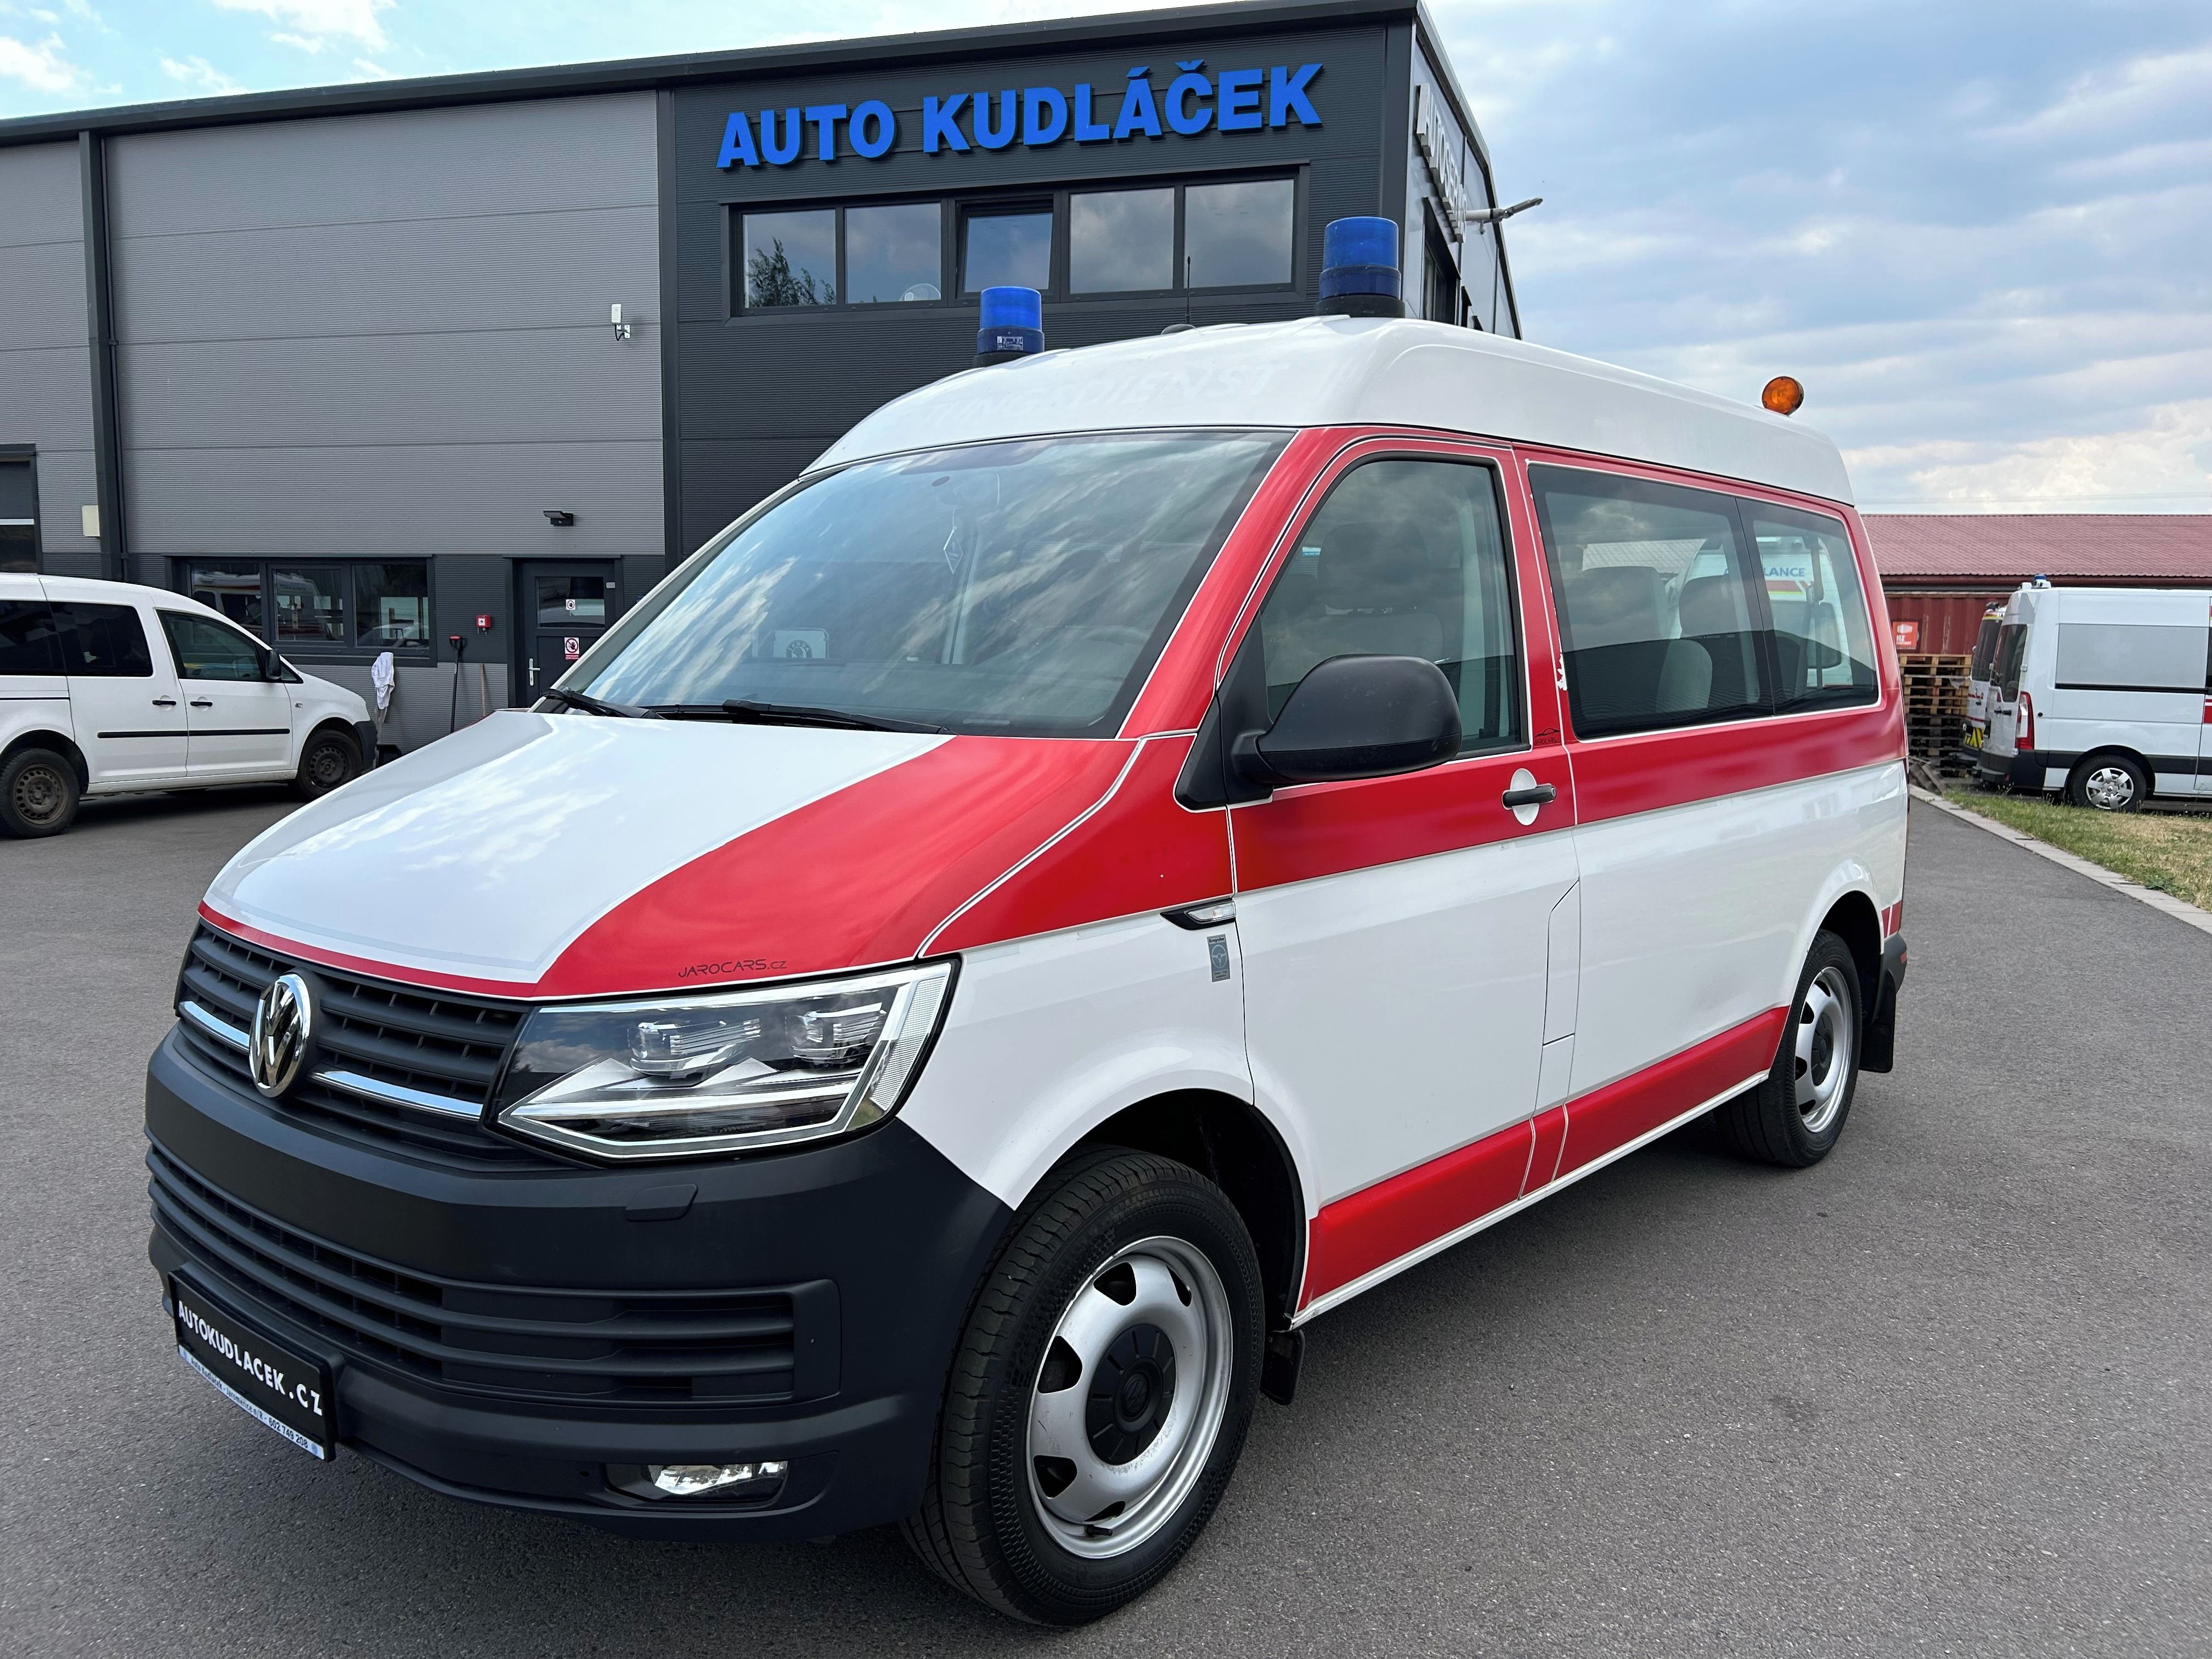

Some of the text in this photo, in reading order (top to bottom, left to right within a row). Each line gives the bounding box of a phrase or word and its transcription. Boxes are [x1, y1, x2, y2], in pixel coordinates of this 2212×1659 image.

[716, 59, 1323, 169] AUTO KUDLÁČEK
[178, 1300, 323, 1417] AUTOKUDLACEK.CZ
[268, 1417, 281, 1432] 602
[281, 1425, 294, 1440] 749
[295, 1434, 308, 1449] 208
